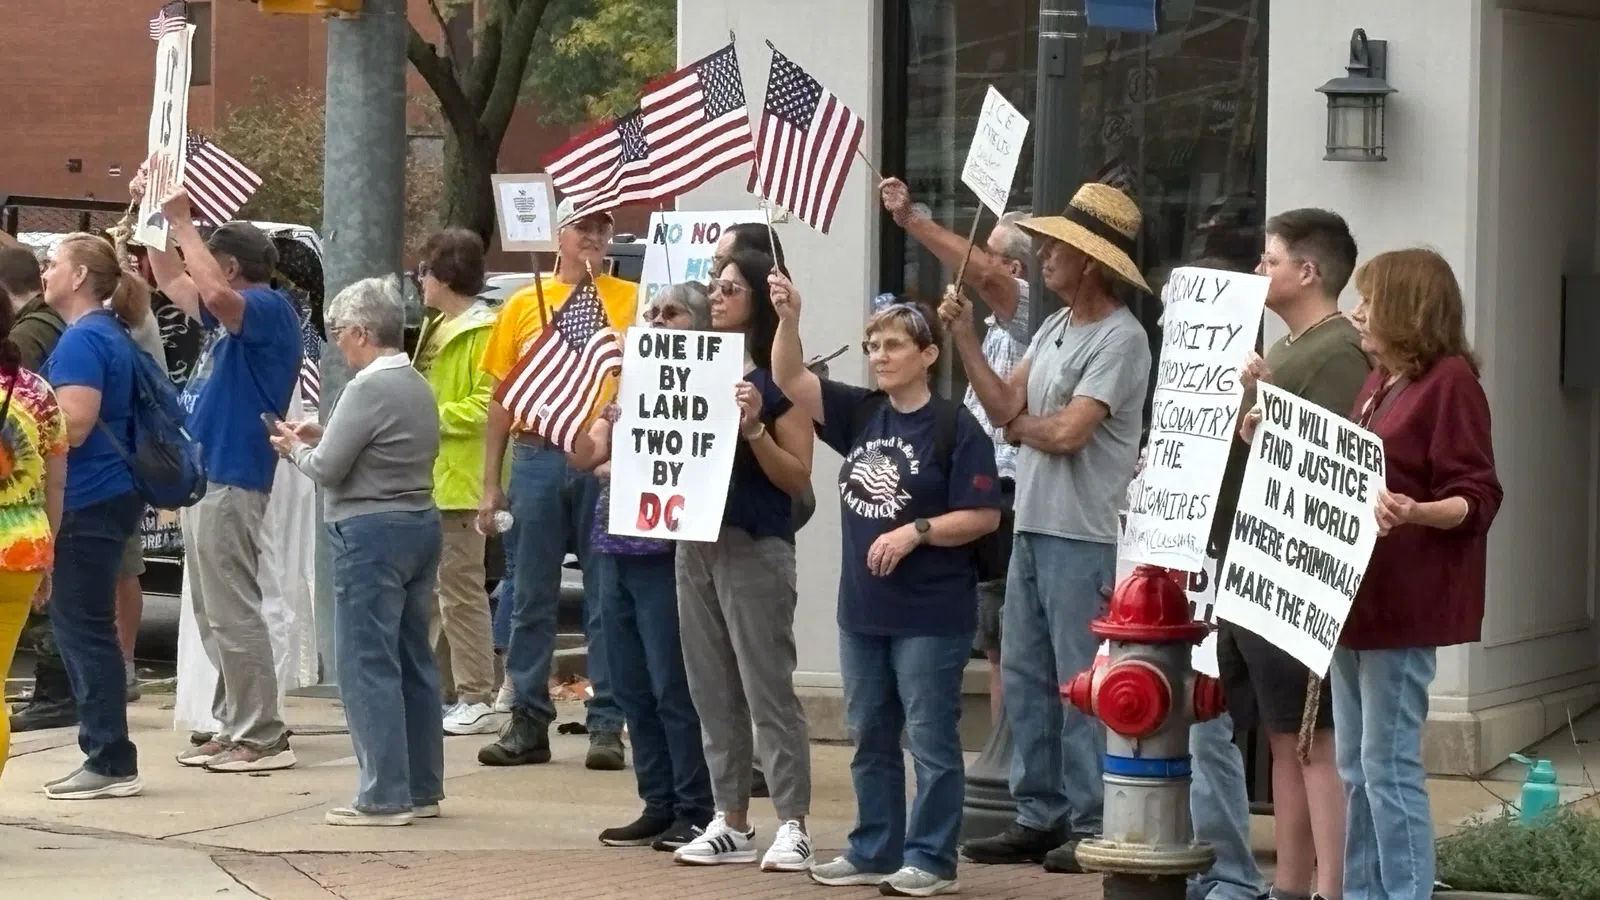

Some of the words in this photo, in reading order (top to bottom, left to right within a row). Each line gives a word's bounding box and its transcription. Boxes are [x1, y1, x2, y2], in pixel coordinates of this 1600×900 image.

[160, 100, 172, 147] IS
[986, 91, 1016, 131] ICE
[653, 223, 683, 245] NO
[691, 222, 721, 244] NO
[638, 333, 687, 360] ONE
[697, 335, 723, 361] IF
[659, 365, 691, 392] BY
[638, 393, 709, 421] LAND
[1160, 400, 1237, 436] COUNTRY
[631, 428, 683, 455] TWO
[692, 431, 715, 457] IF
[1263, 390, 1293, 430] YOU
[1298, 406, 1329, 450] WILL
[1336, 425, 1383, 477] NEVER
[1153, 438, 1185, 469] THE
[1260, 430, 1293, 471] FIND
[1298, 449, 1368, 504] JUSTICE
[652, 460, 684, 487] BY
[636, 492, 686, 532] DC
[839, 482, 912, 519] AMERICAN
[1264, 477, 1281, 510] IN
[1282, 486, 1295, 519] A
[1304, 493, 1360, 546] WORLD
[1234, 510, 1285, 563] WHERE
[1285, 536, 1362, 602] CRIMINALS
[1225, 562, 1275, 611] MAKE
[1275, 585, 1305, 629] THE
[1302, 601, 1340, 651] RULES
